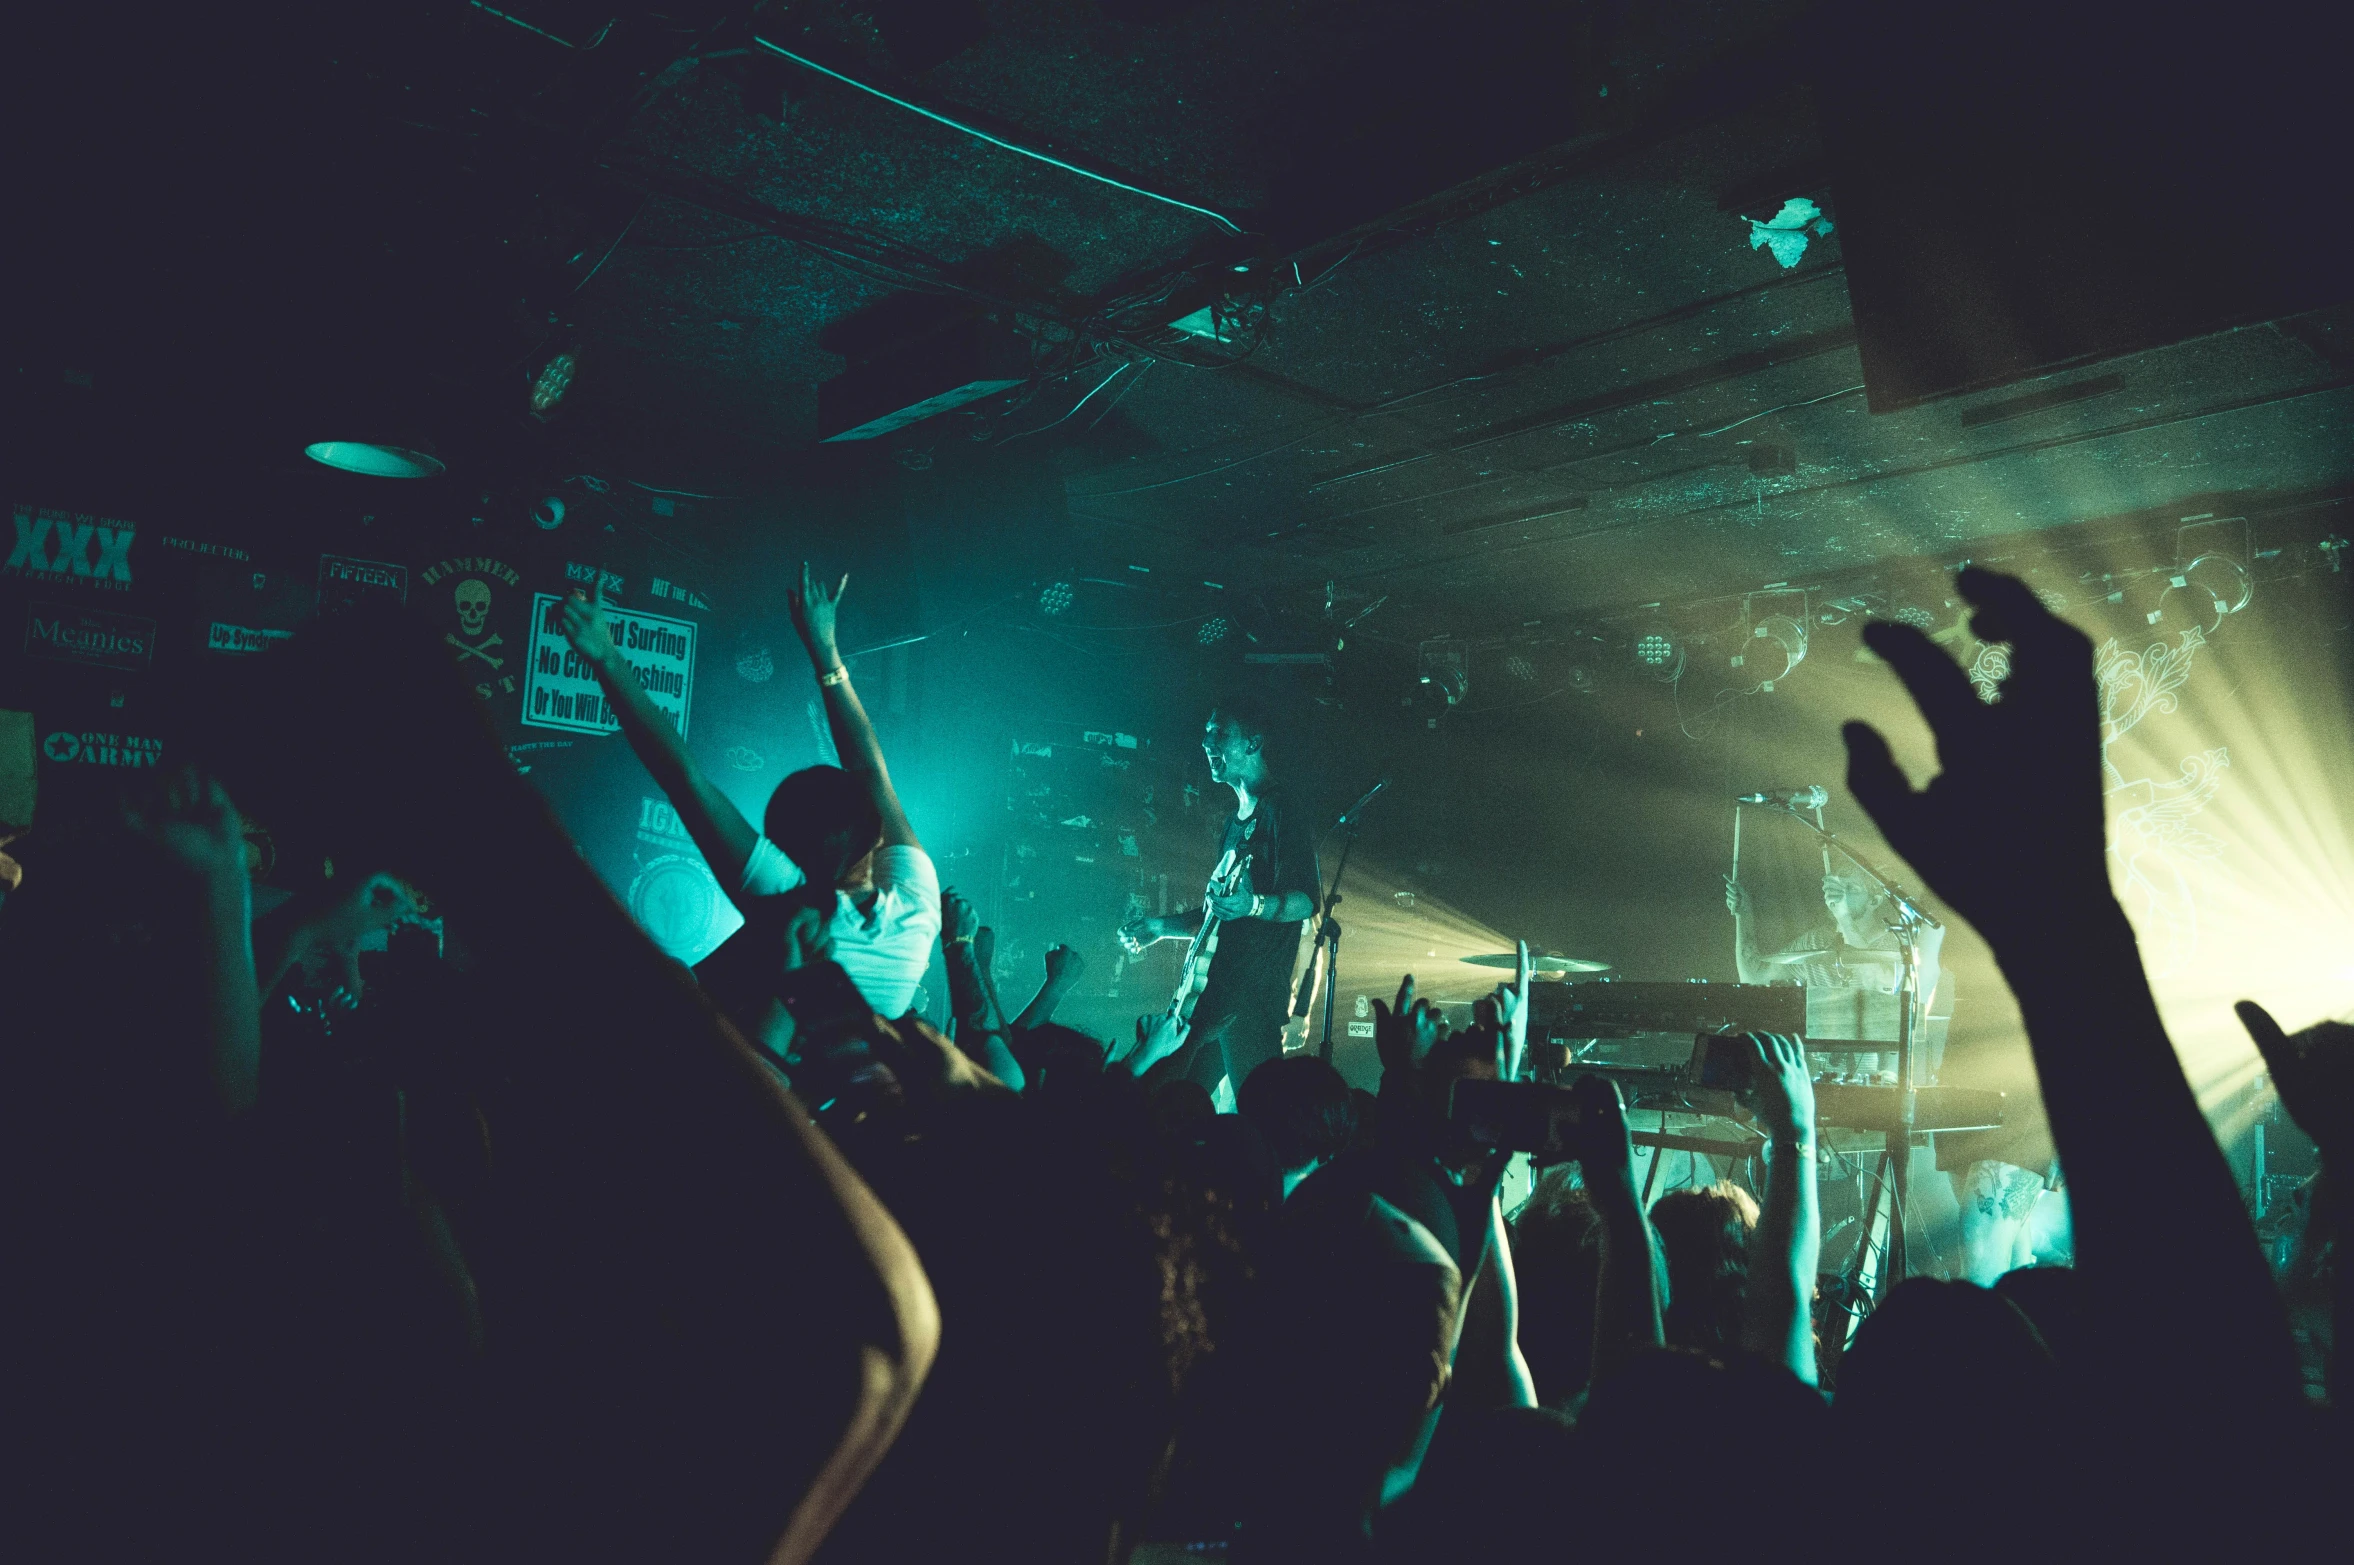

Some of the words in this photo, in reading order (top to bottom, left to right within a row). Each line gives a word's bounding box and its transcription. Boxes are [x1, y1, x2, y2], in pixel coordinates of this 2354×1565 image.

[4, 513, 137, 582] XXX
[94, 580, 133, 592] EDGE
[329, 562, 398, 589] FIFTEEN
[421, 557, 520, 587] HAMMER
[651, 577, 671, 598] HIT
[672, 586, 687, 602] THE
[31, 617, 144, 655] Meanies
[213, 625, 230, 647] Up
[234, 629, 268, 653] Syndr
[628, 621, 686, 661] Surfing
[538, 645, 560, 675] No
[534, 686, 550, 715] Or
[551, 688, 573, 719] You
[574, 692, 600, 723] Will
[81, 731, 120, 747] ONE
[126, 735, 163, 751] MAN
[538, 741, 555, 749] THE
[78, 745, 162, 768] ARMY
